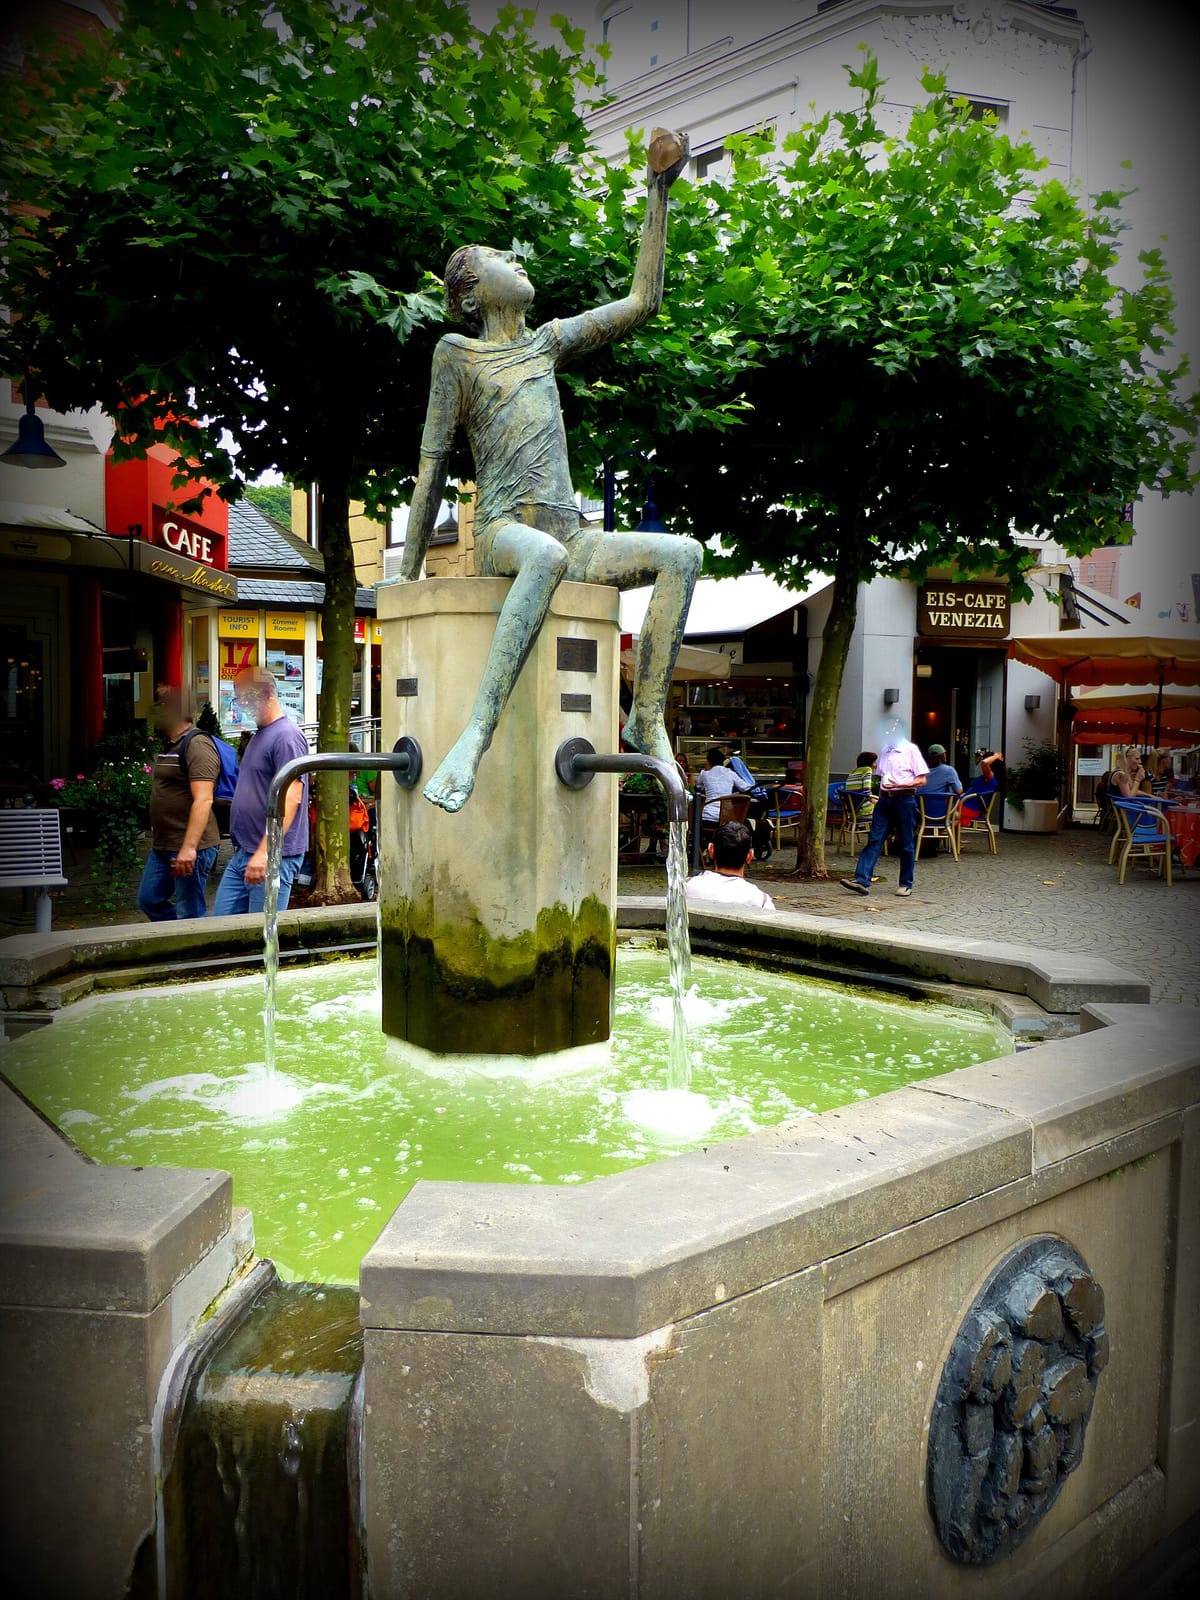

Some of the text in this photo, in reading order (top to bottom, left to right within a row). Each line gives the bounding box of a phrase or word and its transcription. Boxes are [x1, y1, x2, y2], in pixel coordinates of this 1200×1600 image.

[162, 522, 214, 563] CAFE
[926, 592, 1006, 609] EIS-CAFE
[928, 612, 1004, 629] VENEZIA
[224, 642, 254, 668] 17
